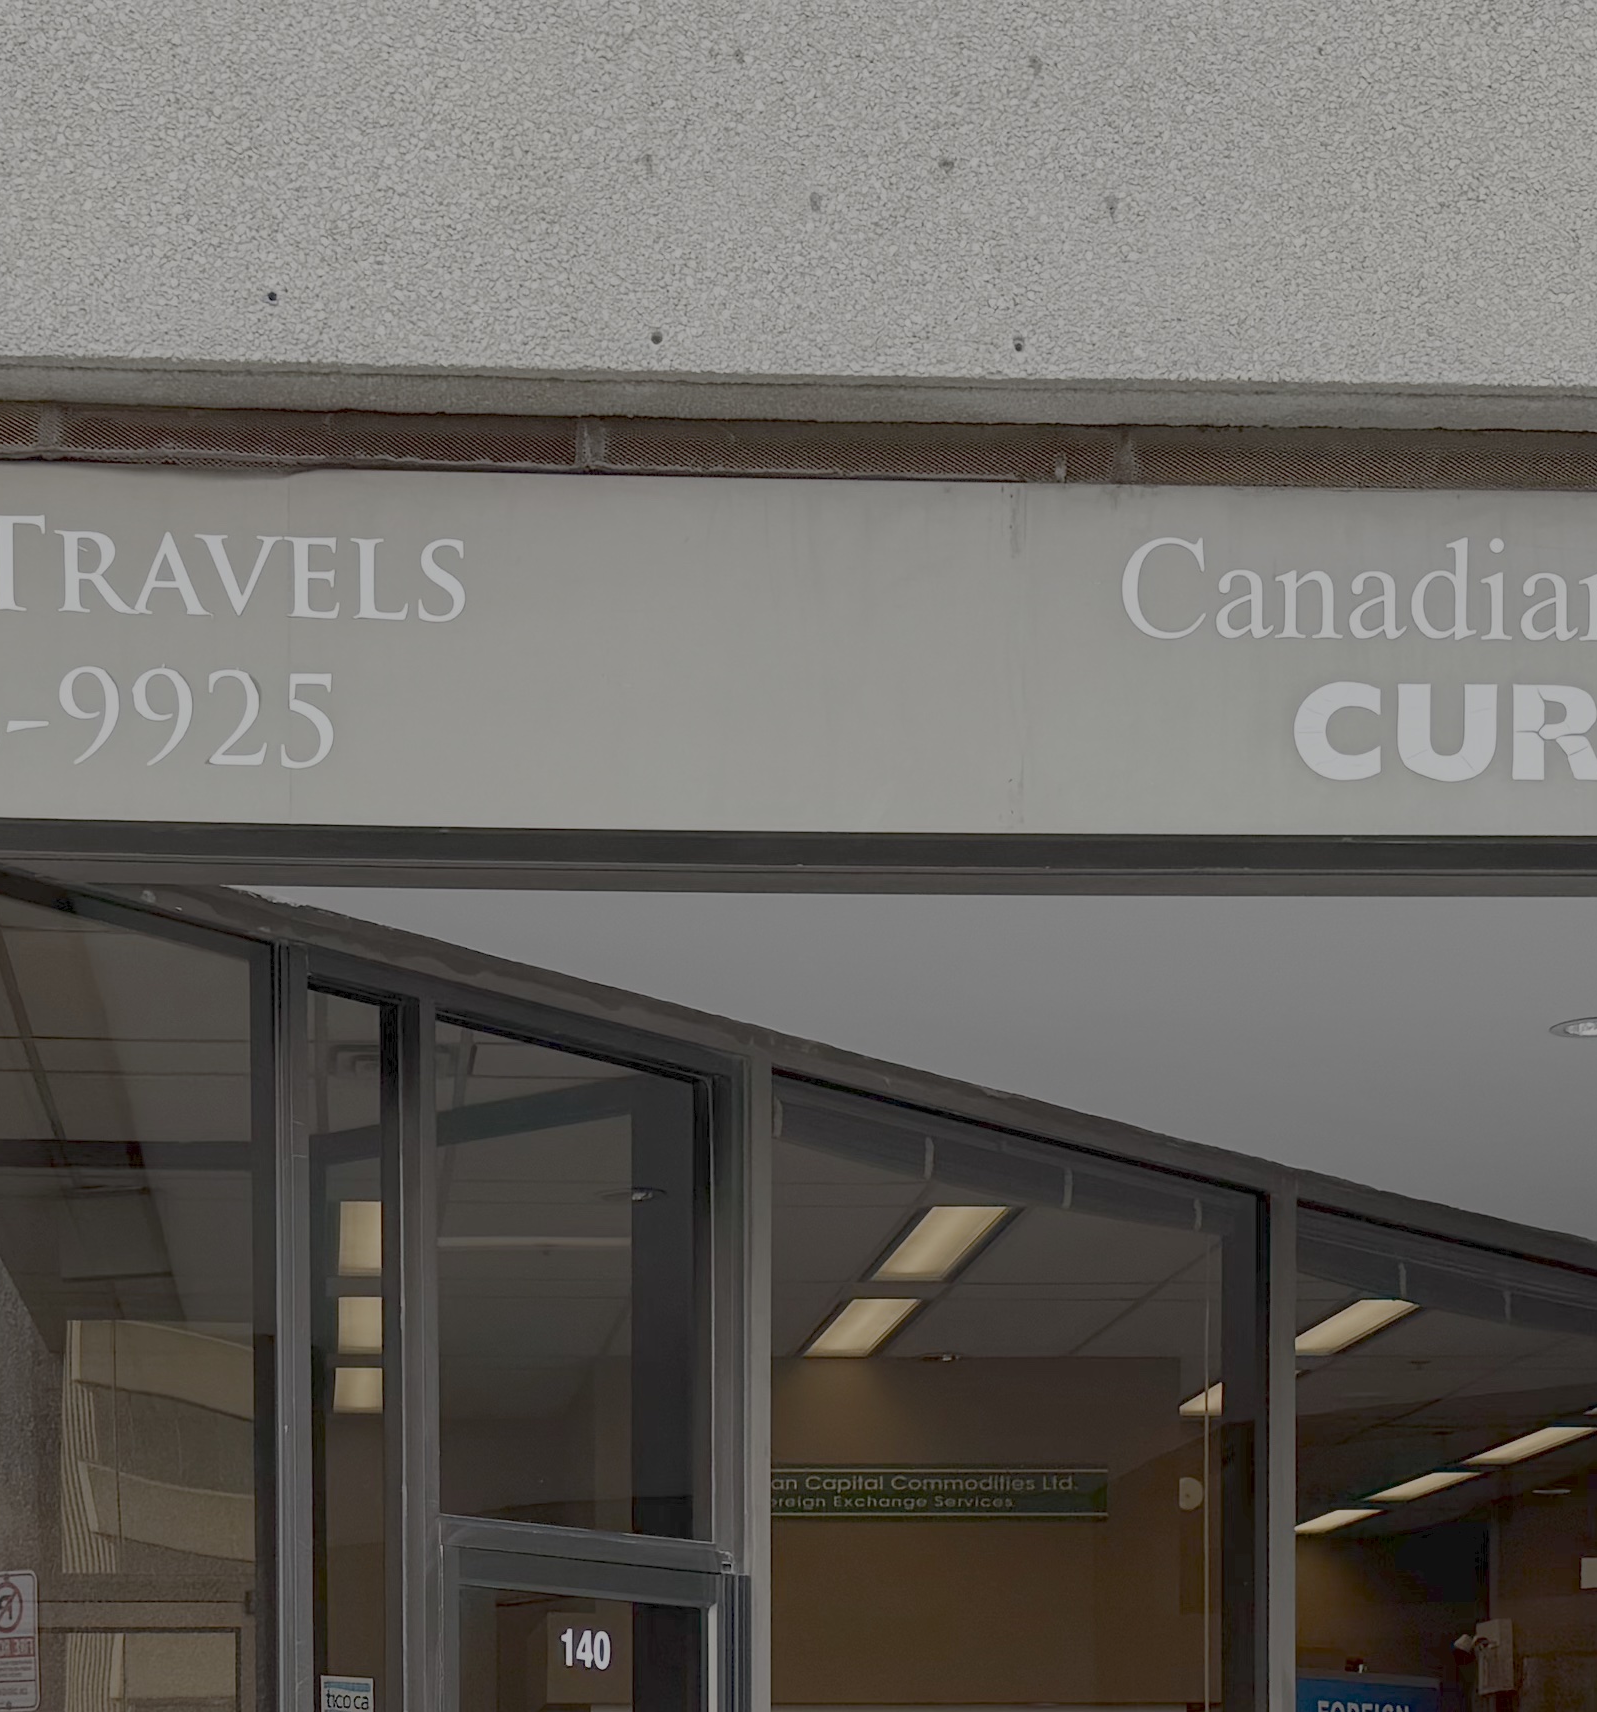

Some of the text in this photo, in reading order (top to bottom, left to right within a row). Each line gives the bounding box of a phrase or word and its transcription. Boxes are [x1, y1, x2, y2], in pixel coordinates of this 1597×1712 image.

[805, 1475, 884, 1493] Capital
[891, 1475, 1035, 1491] Commodities
[833, 1496, 928, 1510] Exchange
[934, 1495, 1014, 1508] Services
[560, 1629, 611, 1671] 140
